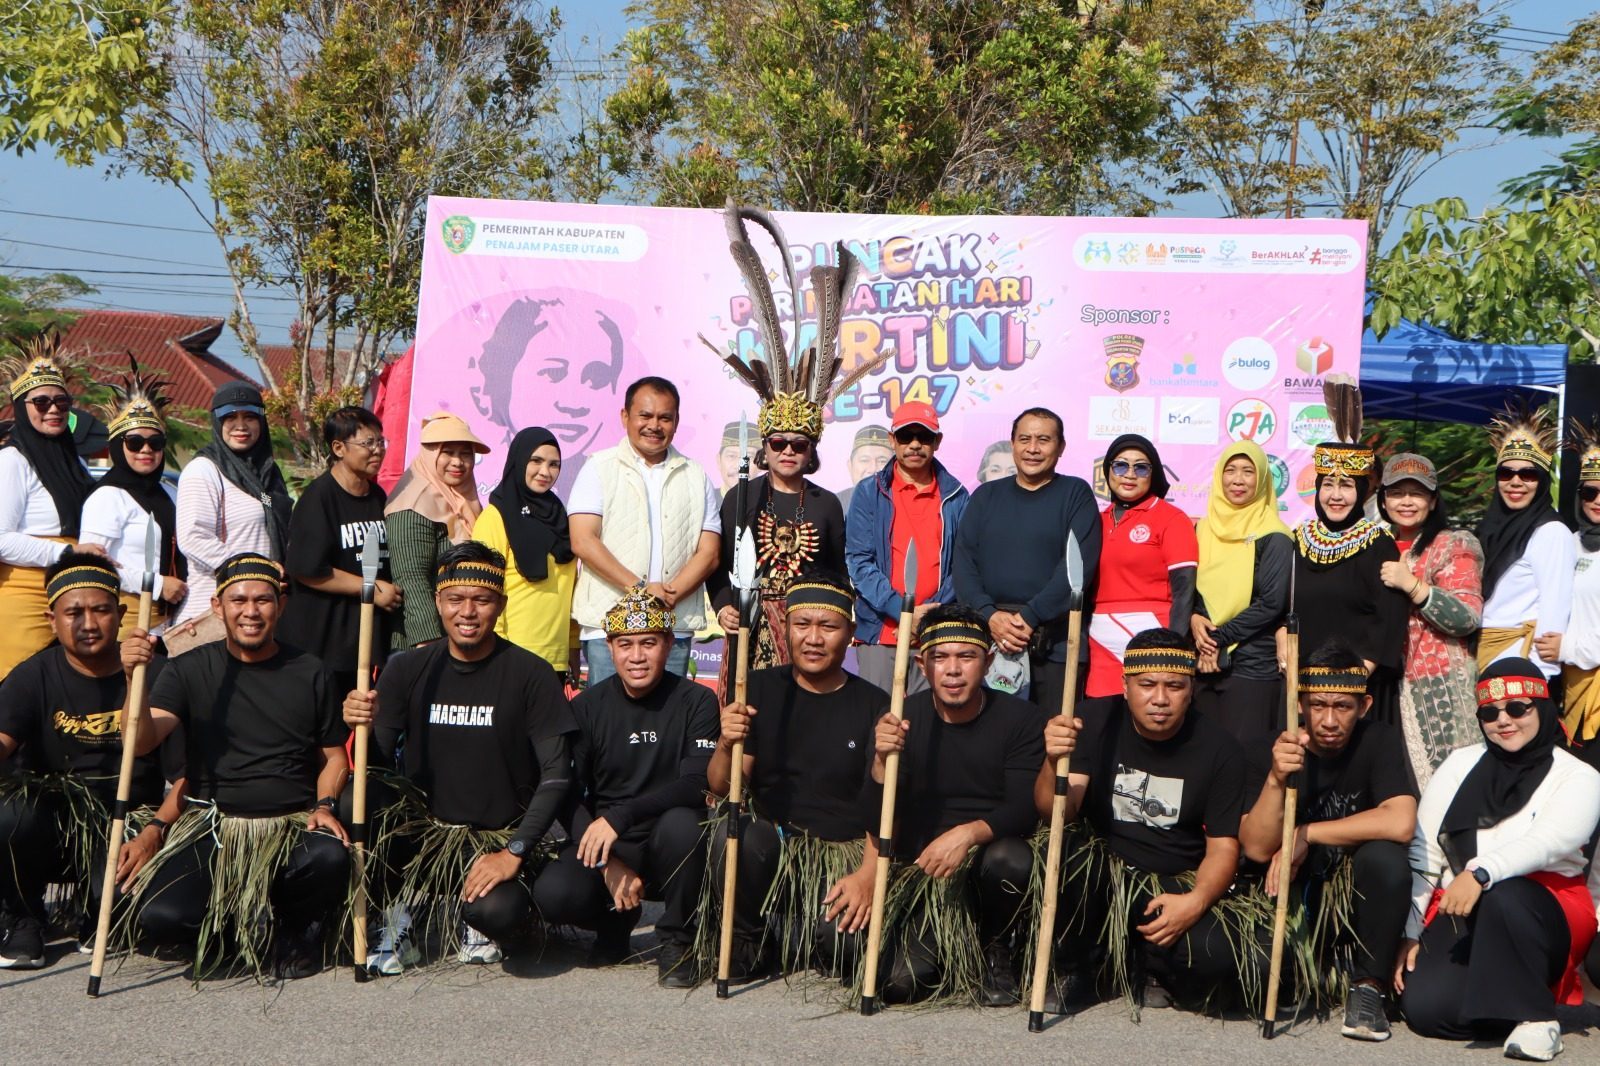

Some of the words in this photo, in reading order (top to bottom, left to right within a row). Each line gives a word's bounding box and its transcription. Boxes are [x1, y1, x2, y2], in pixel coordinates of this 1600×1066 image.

[482, 224, 554, 236] PEMERINTAH
[556, 226, 625, 239] KABUPATEN
[485, 240, 541, 251] PENAJAM
[543, 242, 578, 253] PASER
[581, 244, 620, 255] UTARA
[1251, 251, 1305, 259] BerAKHLAK
[949, 276, 1032, 309] HARI
[1081, 304, 1161, 326] Sponsor
[1238, 357, 1270, 370] bulog
[1284, 378, 1323, 388] BAWA
[823, 374, 959, 424] E-147
[1229, 411, 1274, 440] PJA
[690, 649, 723, 662] Dinas
[429, 703, 494, 727] MACBLACK
[641, 731, 658, 743] T8
